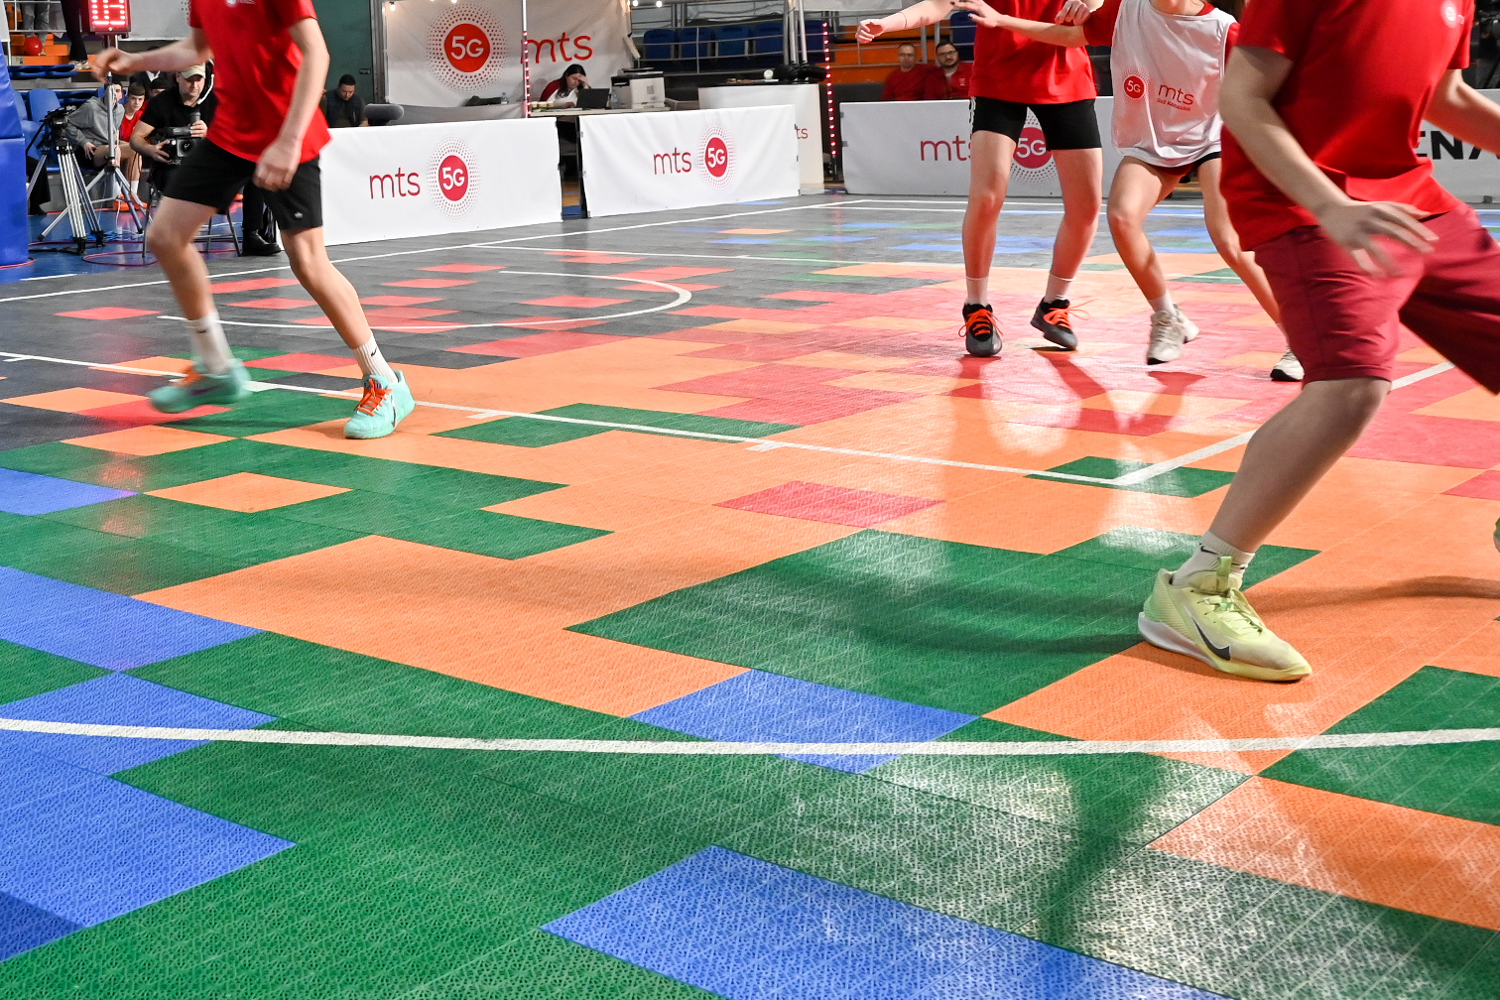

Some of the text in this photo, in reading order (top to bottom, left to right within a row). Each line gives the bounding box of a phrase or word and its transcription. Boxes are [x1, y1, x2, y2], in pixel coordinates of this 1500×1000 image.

[450, 31, 594, 65] 5G mts
[1126, 80, 1194, 105] 5G mts
[653, 146, 726, 176] mts 5G
[920, 135, 1047, 161] mt 5G
[369, 167, 466, 200] mts 5G
